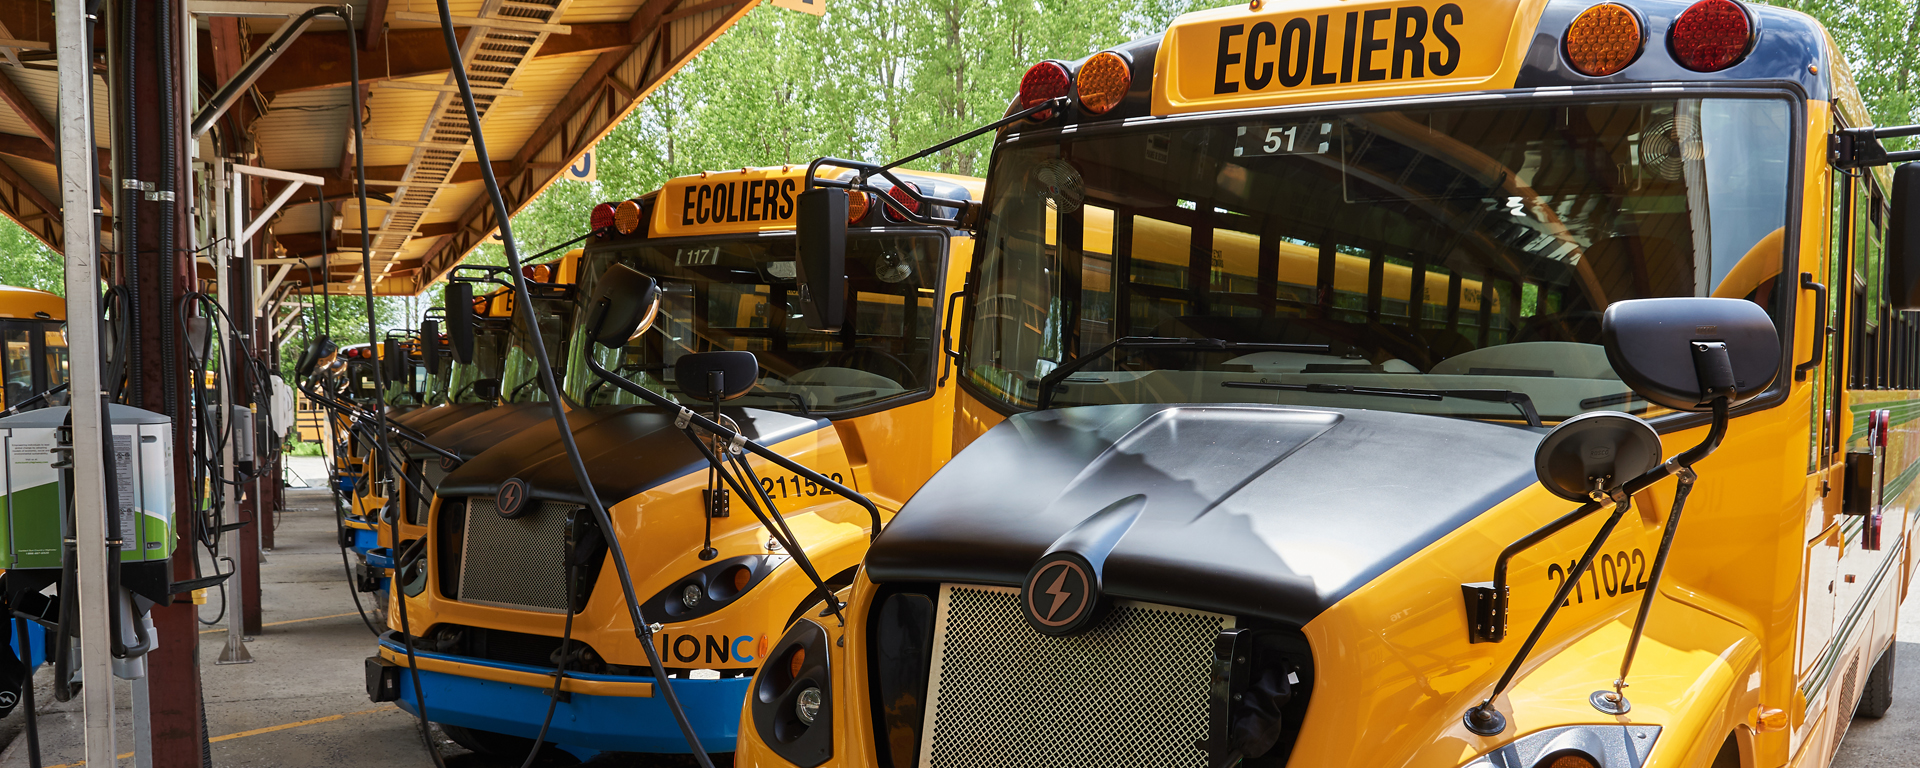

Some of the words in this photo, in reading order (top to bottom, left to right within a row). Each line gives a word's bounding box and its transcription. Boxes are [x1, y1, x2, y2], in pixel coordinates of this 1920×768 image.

[1214, 3, 1463, 95] ECOLIERS
[1263, 126, 1297, 153] 51
[682, 179, 796, 226] ECOLIERS
[687, 249, 710, 264] 117
[1547, 548, 1648, 608] 211022
